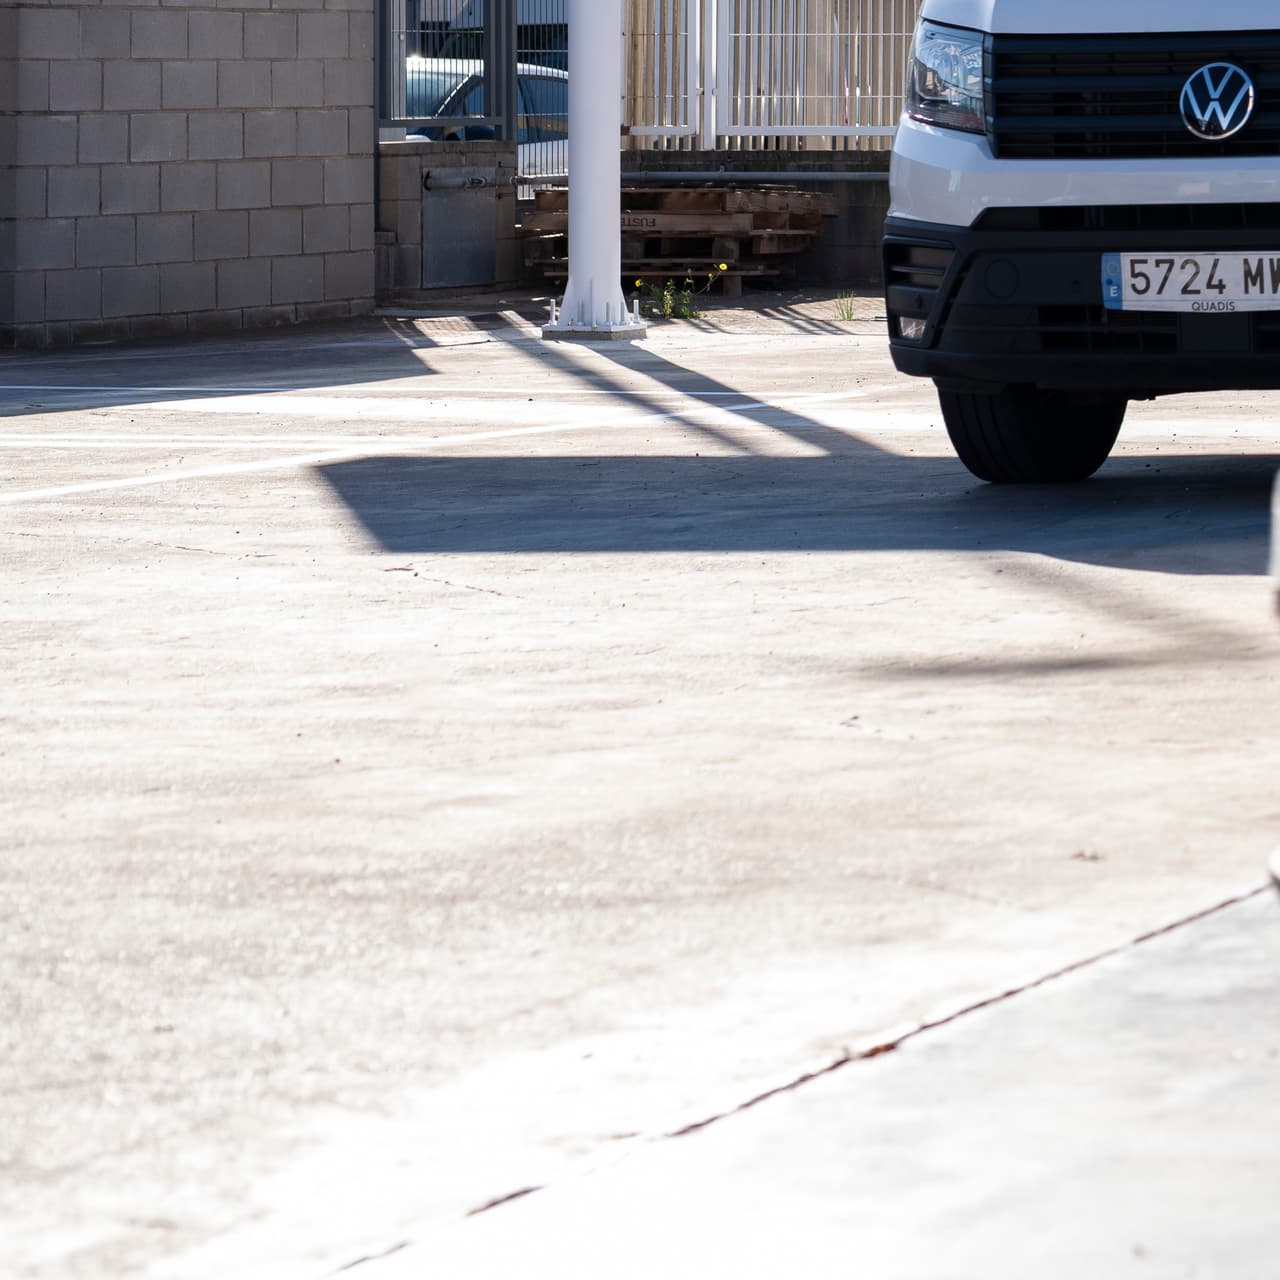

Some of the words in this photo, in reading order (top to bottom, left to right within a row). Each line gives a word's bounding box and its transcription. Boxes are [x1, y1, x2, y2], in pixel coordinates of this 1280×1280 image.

[1129, 258, 1227, 295] 5724
[1109, 285, 1119, 297] E
[1191, 301, 1236, 312] QUADIS
